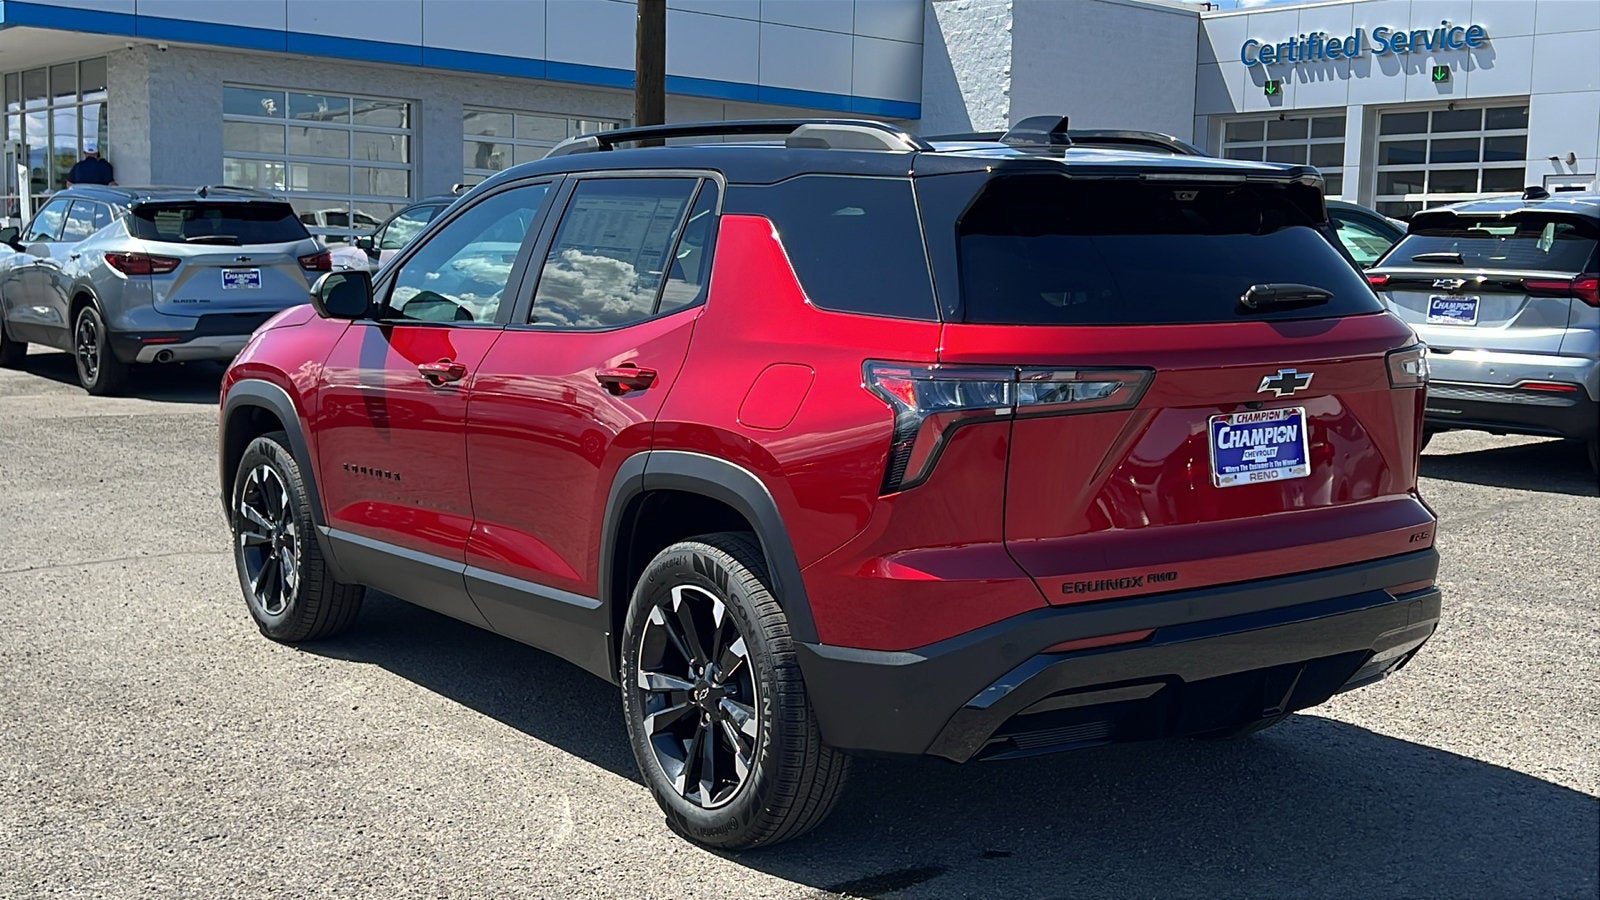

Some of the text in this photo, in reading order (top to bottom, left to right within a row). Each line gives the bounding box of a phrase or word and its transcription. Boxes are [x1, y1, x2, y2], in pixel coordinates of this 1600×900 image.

[1241, 20, 1485, 66] Certified Service
[225, 272, 257, 280] CHAMPION
[1432, 300, 1475, 310] CHAMPION
[1237, 411, 1280, 424] CHAMPION
[1217, 425, 1297, 449] CHAMPION
[1244, 448, 1276, 458] CHEVROLET
[1250, 470, 1279, 481] RENO
[1062, 571, 1178, 594] EQUINOX AWD
